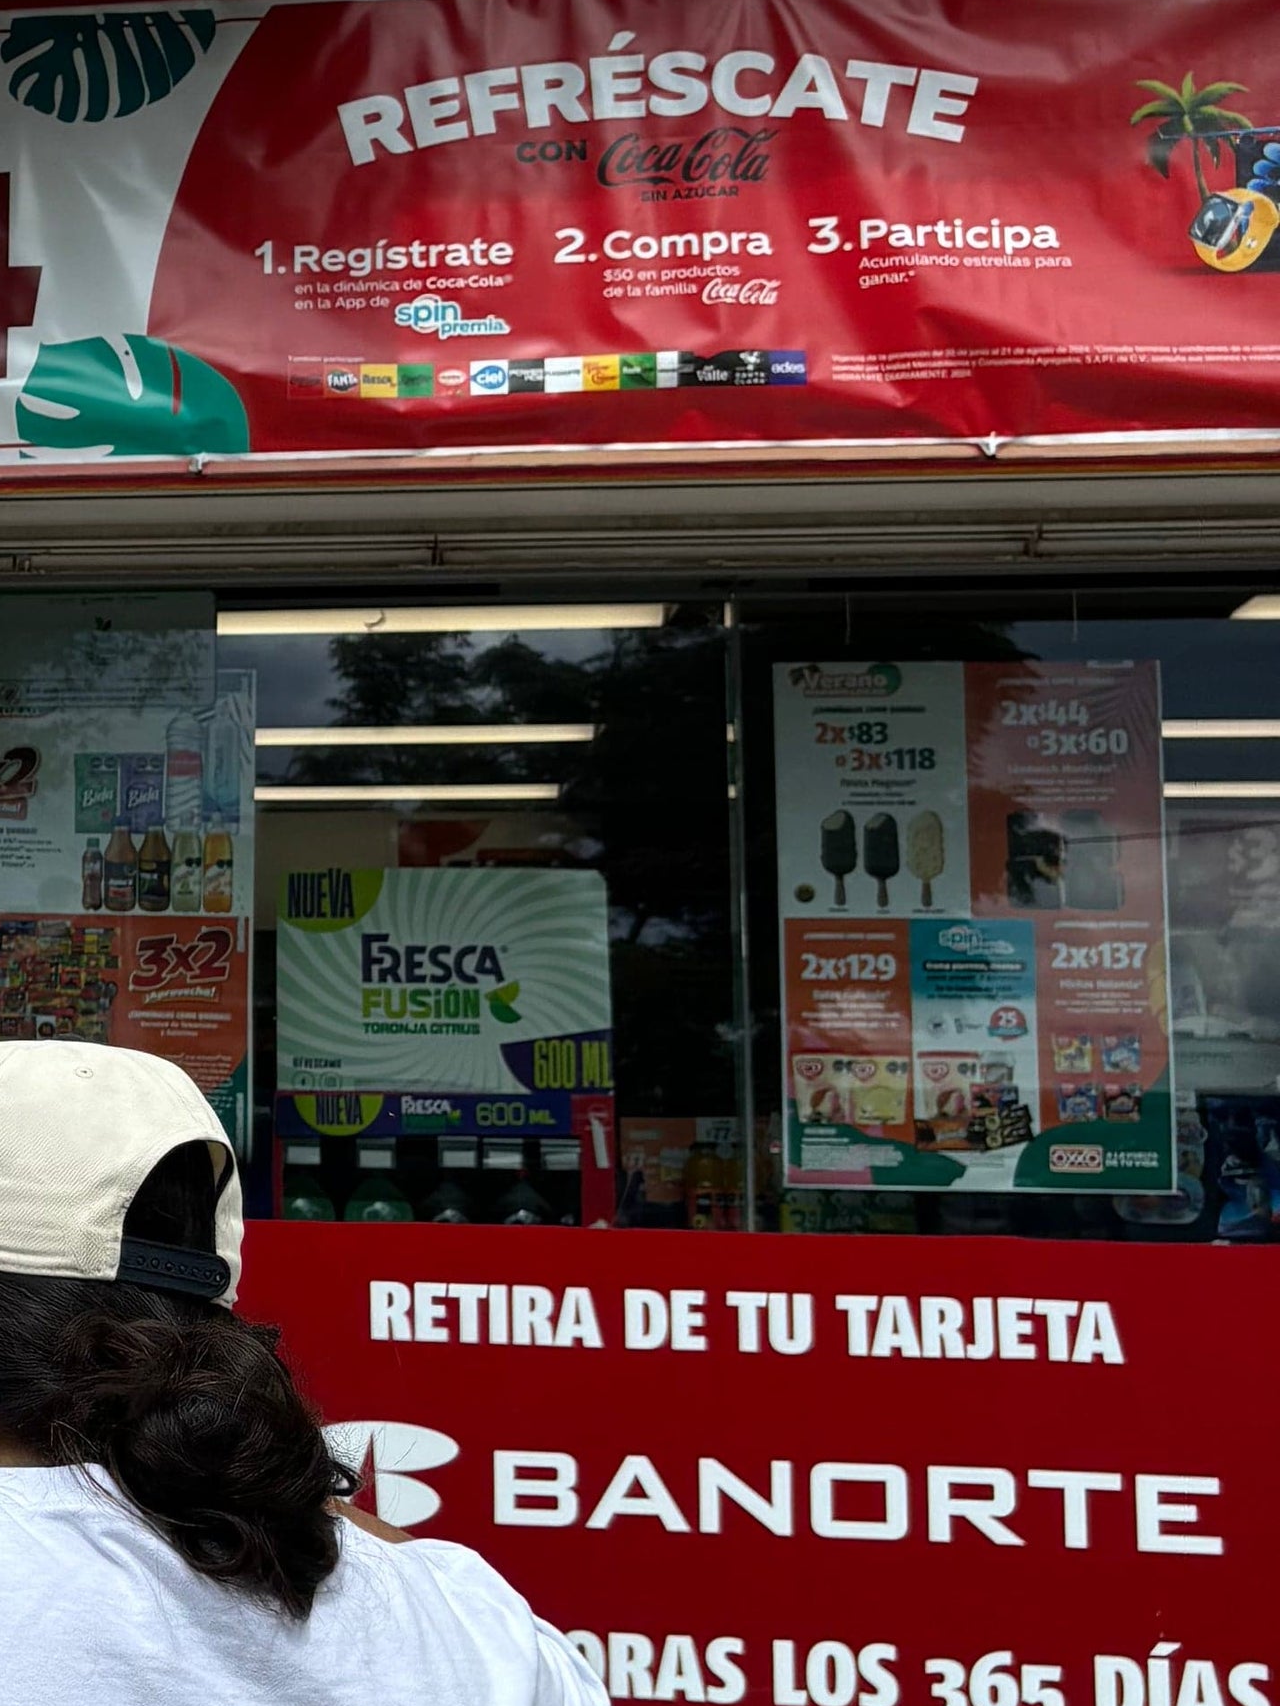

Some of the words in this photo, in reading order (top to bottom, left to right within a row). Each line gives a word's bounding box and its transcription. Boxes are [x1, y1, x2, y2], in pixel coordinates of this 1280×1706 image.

[336, 31, 979, 167] REFRÉSCATE
[515, 139, 588, 163] CON
[641, 190, 667, 202] SIN
[602, 230, 773, 261] Compra
[859, 218, 1060, 254] Participa
[293, 238, 514, 278] Regístrate
[858, 253, 960, 269] Acumulando
[963, 254, 1031, 268] estrellas
[1035, 255, 1072, 269] para
[602, 268, 634, 282] $50
[637, 269, 657, 281] en
[660, 264, 741, 281] productos
[294, 282, 314, 295] en
[316, 280, 330, 294] la
[332, 278, 400, 293] dinámica
[403, 277, 423, 291] de
[602, 285, 623, 298] de
[626, 283, 641, 297] la
[644, 282, 698, 297] familia
[294, 298, 314, 310] en
[317, 295, 331, 309] la
[335, 296, 366, 311] App
[370, 295, 390, 308] de
[395, 298, 459, 325] spin
[475, 368, 505, 385] ciel
[287, 868, 355, 920] NUEVA
[128, 926, 233, 991] 3x2
[362, 1022, 428, 1035] TORONJA
[430, 1022, 481, 1035] CITRUS
[532, 1040, 576, 1089] 600
[475, 1102, 526, 1126] 600
[369, 1280, 604, 1350] RETIRA
[624, 1288, 707, 1351] DE
[725, 1291, 814, 1356] TU
[836, 1295, 1125, 1365] TARJETA
[493, 1450, 1224, 1556] BANORTE
